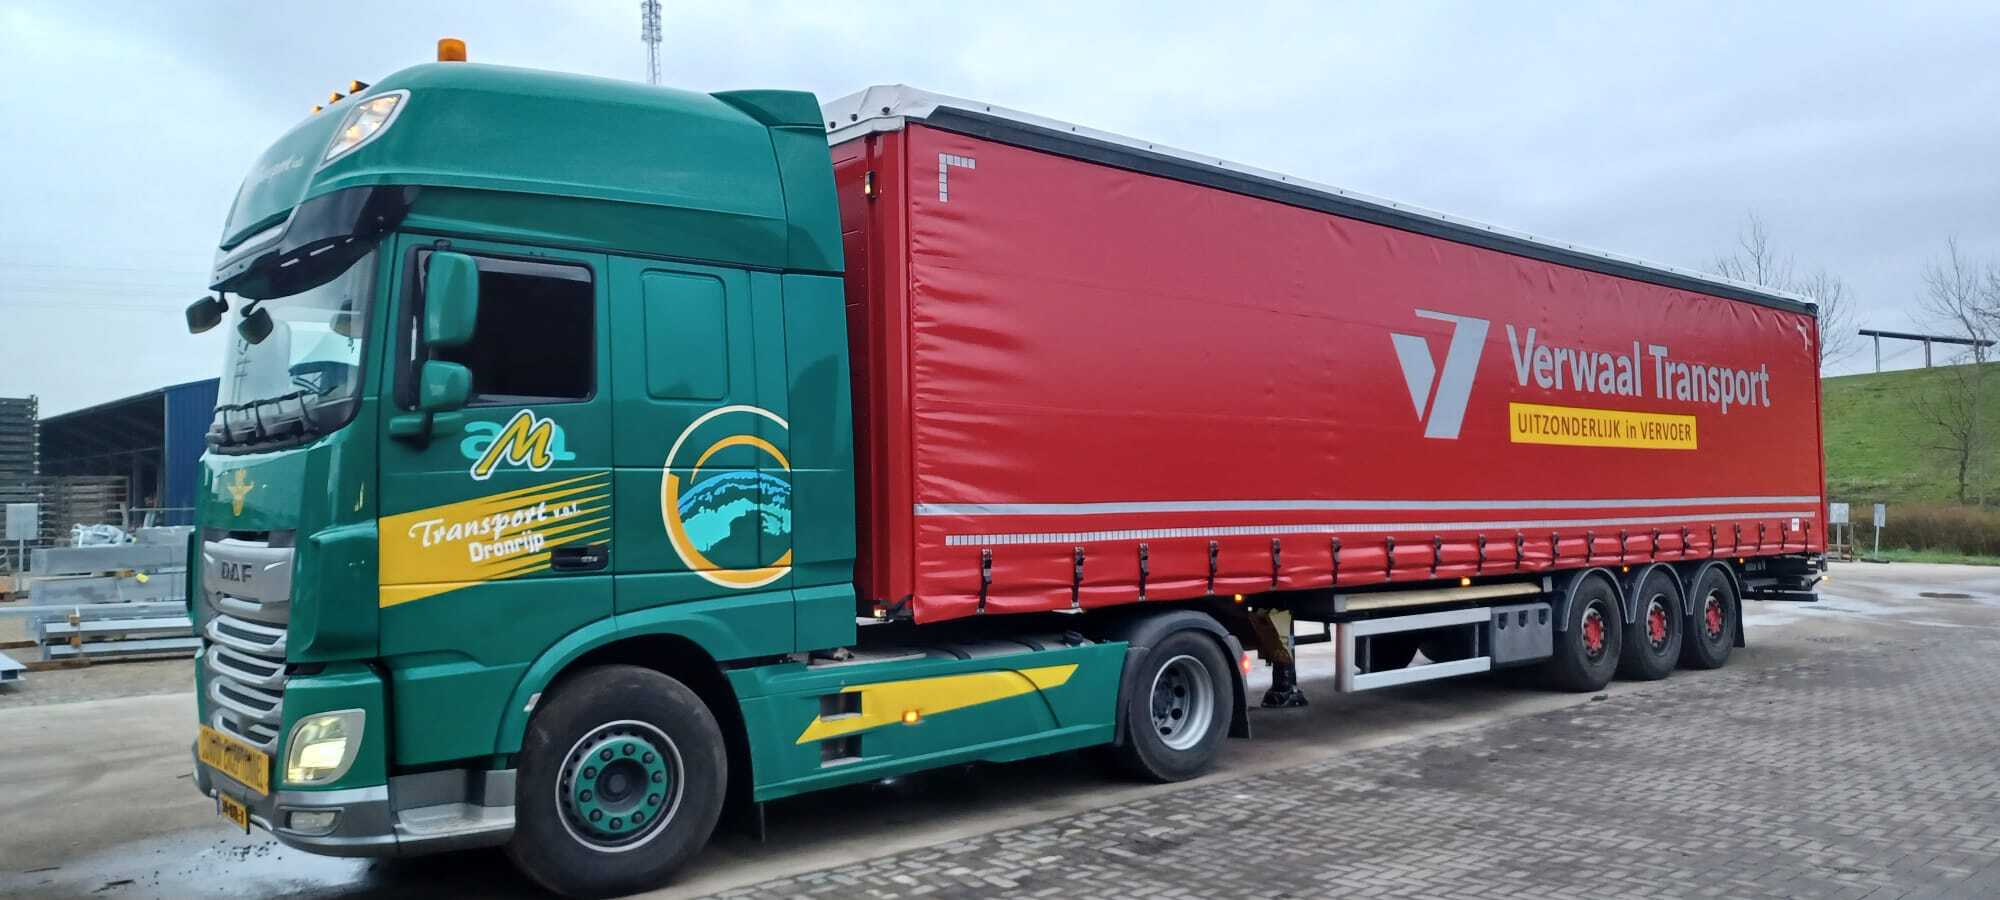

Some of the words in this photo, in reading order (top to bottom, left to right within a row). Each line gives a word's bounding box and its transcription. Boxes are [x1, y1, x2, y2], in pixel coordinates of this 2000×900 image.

[1505, 324, 1643, 398] Verwaal
[1648, 344, 1771, 414] Transport
[1518, 413, 1621, 438] UITZONDERLIJK
[1626, 420, 1637, 439] in
[1640, 420, 1692, 441] VERVOER
[408, 502, 548, 547] Transport
[468, 530, 545, 563] Dronrijp
[221, 561, 252, 582] DAF
